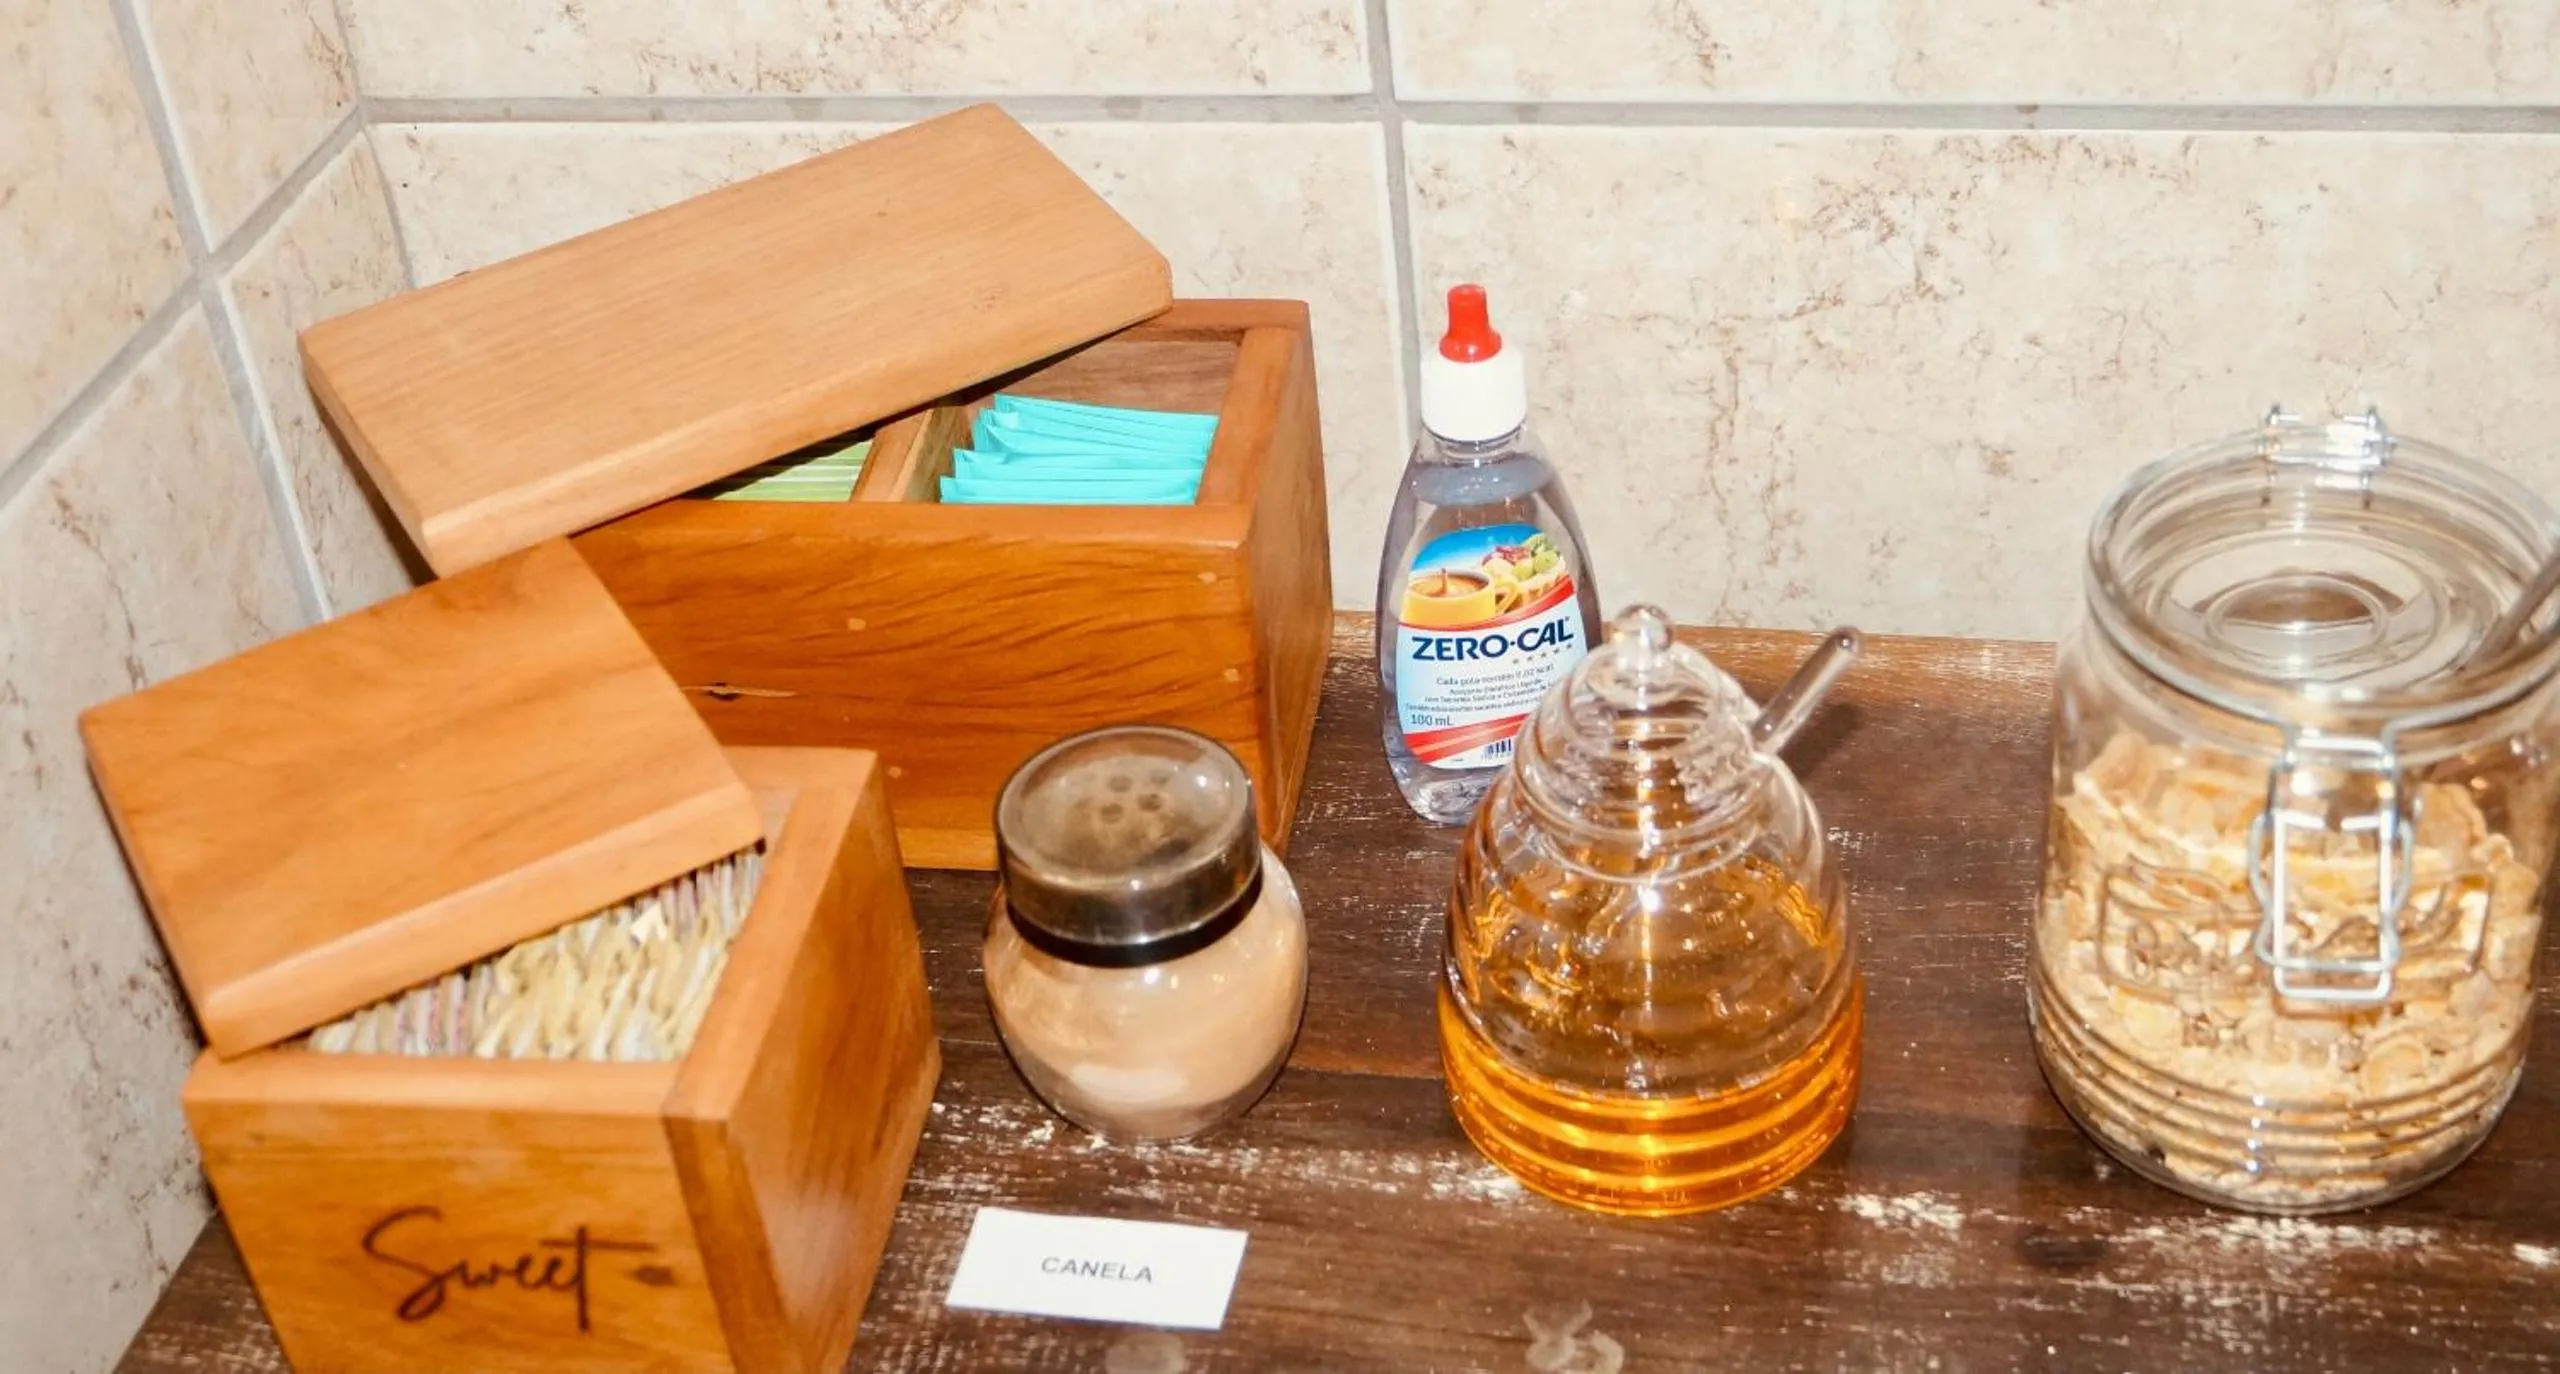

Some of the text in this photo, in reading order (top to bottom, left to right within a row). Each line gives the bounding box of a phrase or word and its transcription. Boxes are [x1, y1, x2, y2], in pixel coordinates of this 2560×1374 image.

[1411, 713, 1433, 726] 100
[361, 1205, 661, 1333] Sweet
[1040, 1256, 1154, 1283] CANELA
